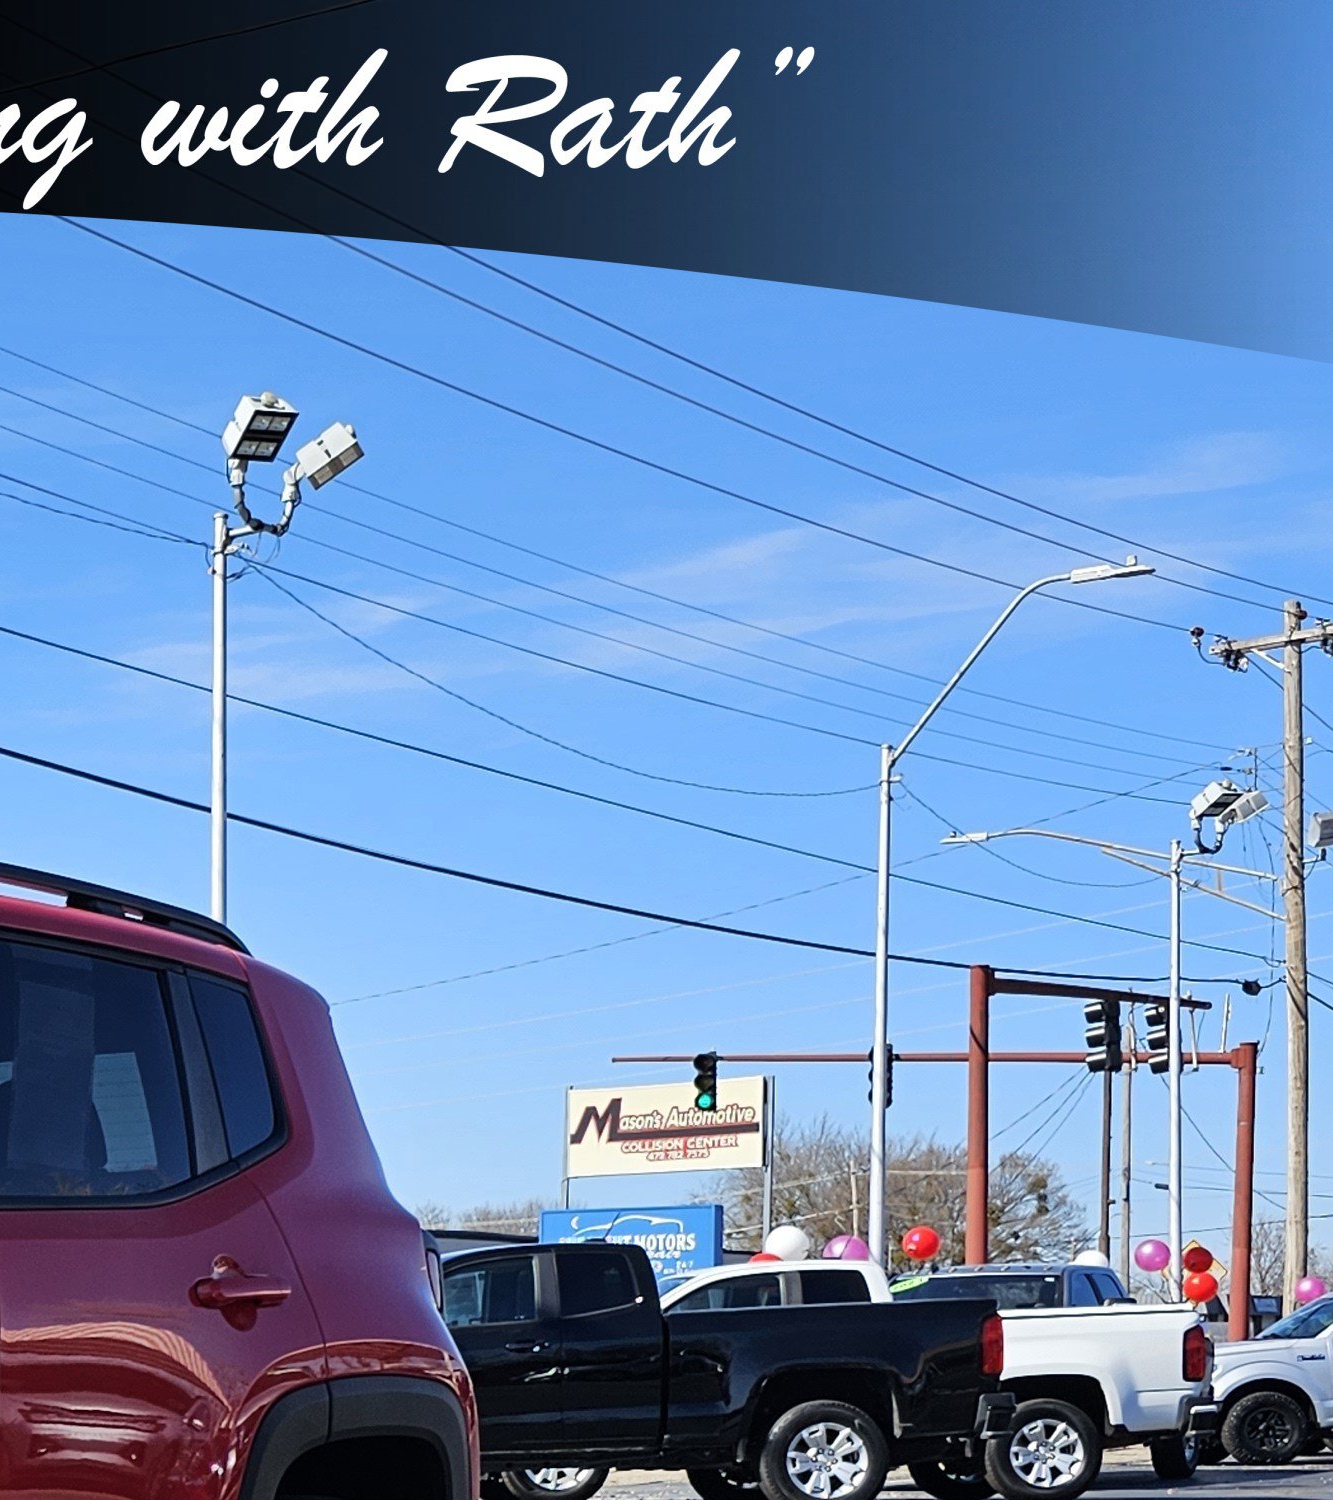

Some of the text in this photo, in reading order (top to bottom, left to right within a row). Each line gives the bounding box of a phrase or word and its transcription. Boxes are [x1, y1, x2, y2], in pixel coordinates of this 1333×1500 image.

[666, 1104, 755, 1129] Automotive
[621, 1136, 737, 1153] COLLISION CENTER
[637, 1233, 696, 1251] MOTORS
